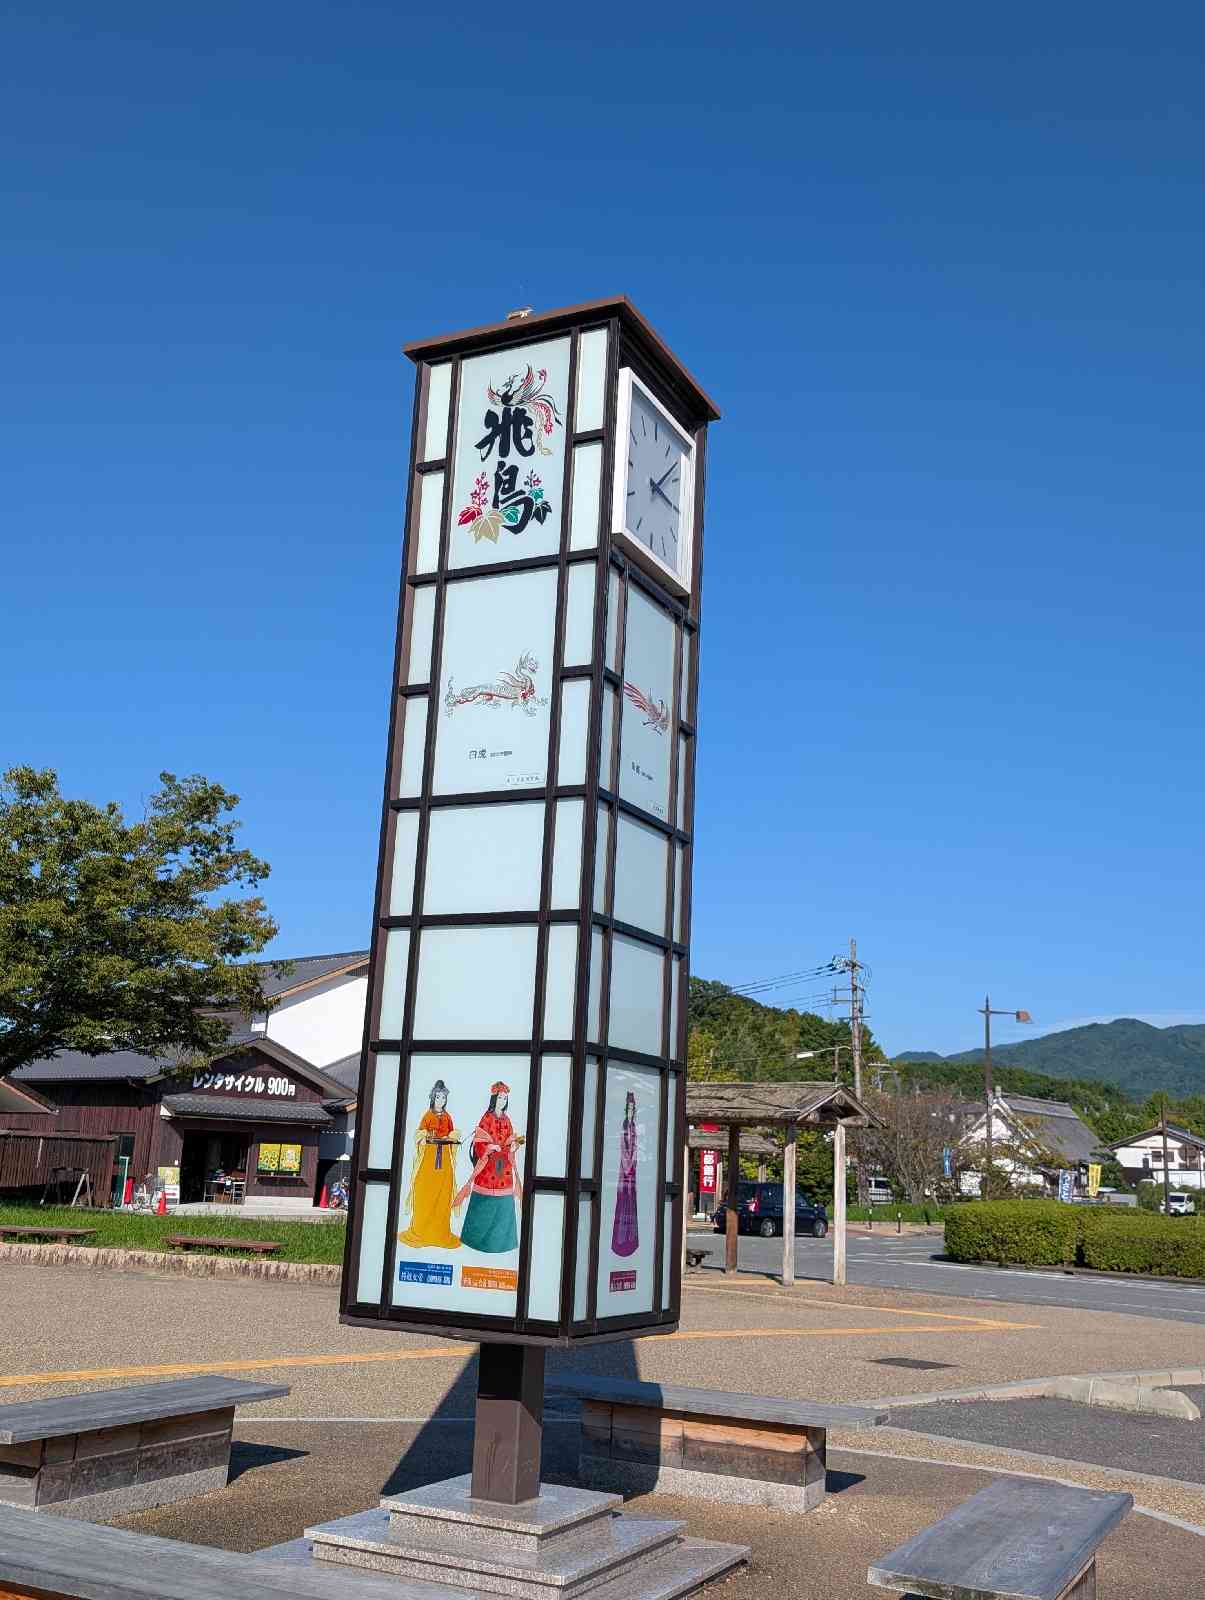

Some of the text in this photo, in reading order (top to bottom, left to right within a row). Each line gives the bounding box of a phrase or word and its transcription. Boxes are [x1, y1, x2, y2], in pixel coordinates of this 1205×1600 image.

[474, 406, 536, 535] 飛鳥
[192, 1072, 296, 1097] レンタサイクル 900円
[703, 1149, 715, 1187] 都銀行
